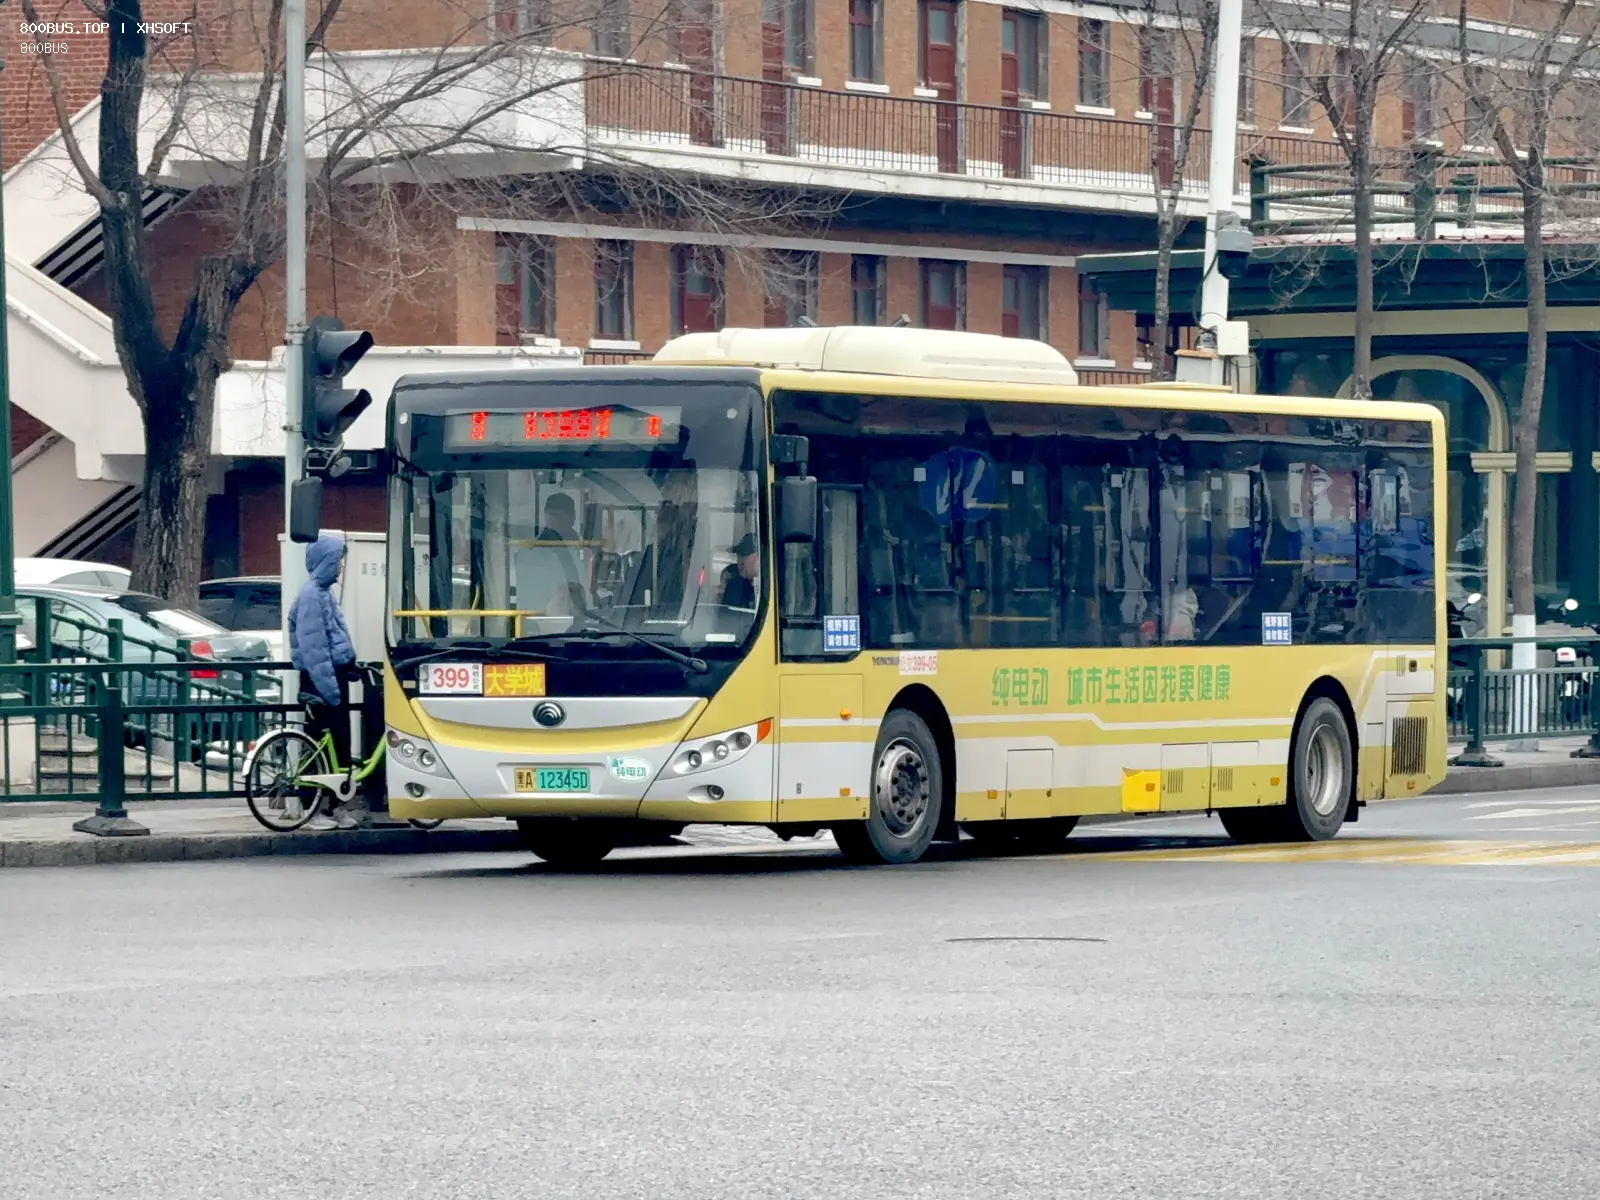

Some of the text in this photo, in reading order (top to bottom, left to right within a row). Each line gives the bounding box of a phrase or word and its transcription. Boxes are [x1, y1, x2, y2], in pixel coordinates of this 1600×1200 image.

[433, 667, 470, 689] 399
[486, 665, 544, 695] 大学城
[991, 664, 1231, 706] 纯电动 城市生活因我更健康
[539, 771, 588, 789] 12345D
